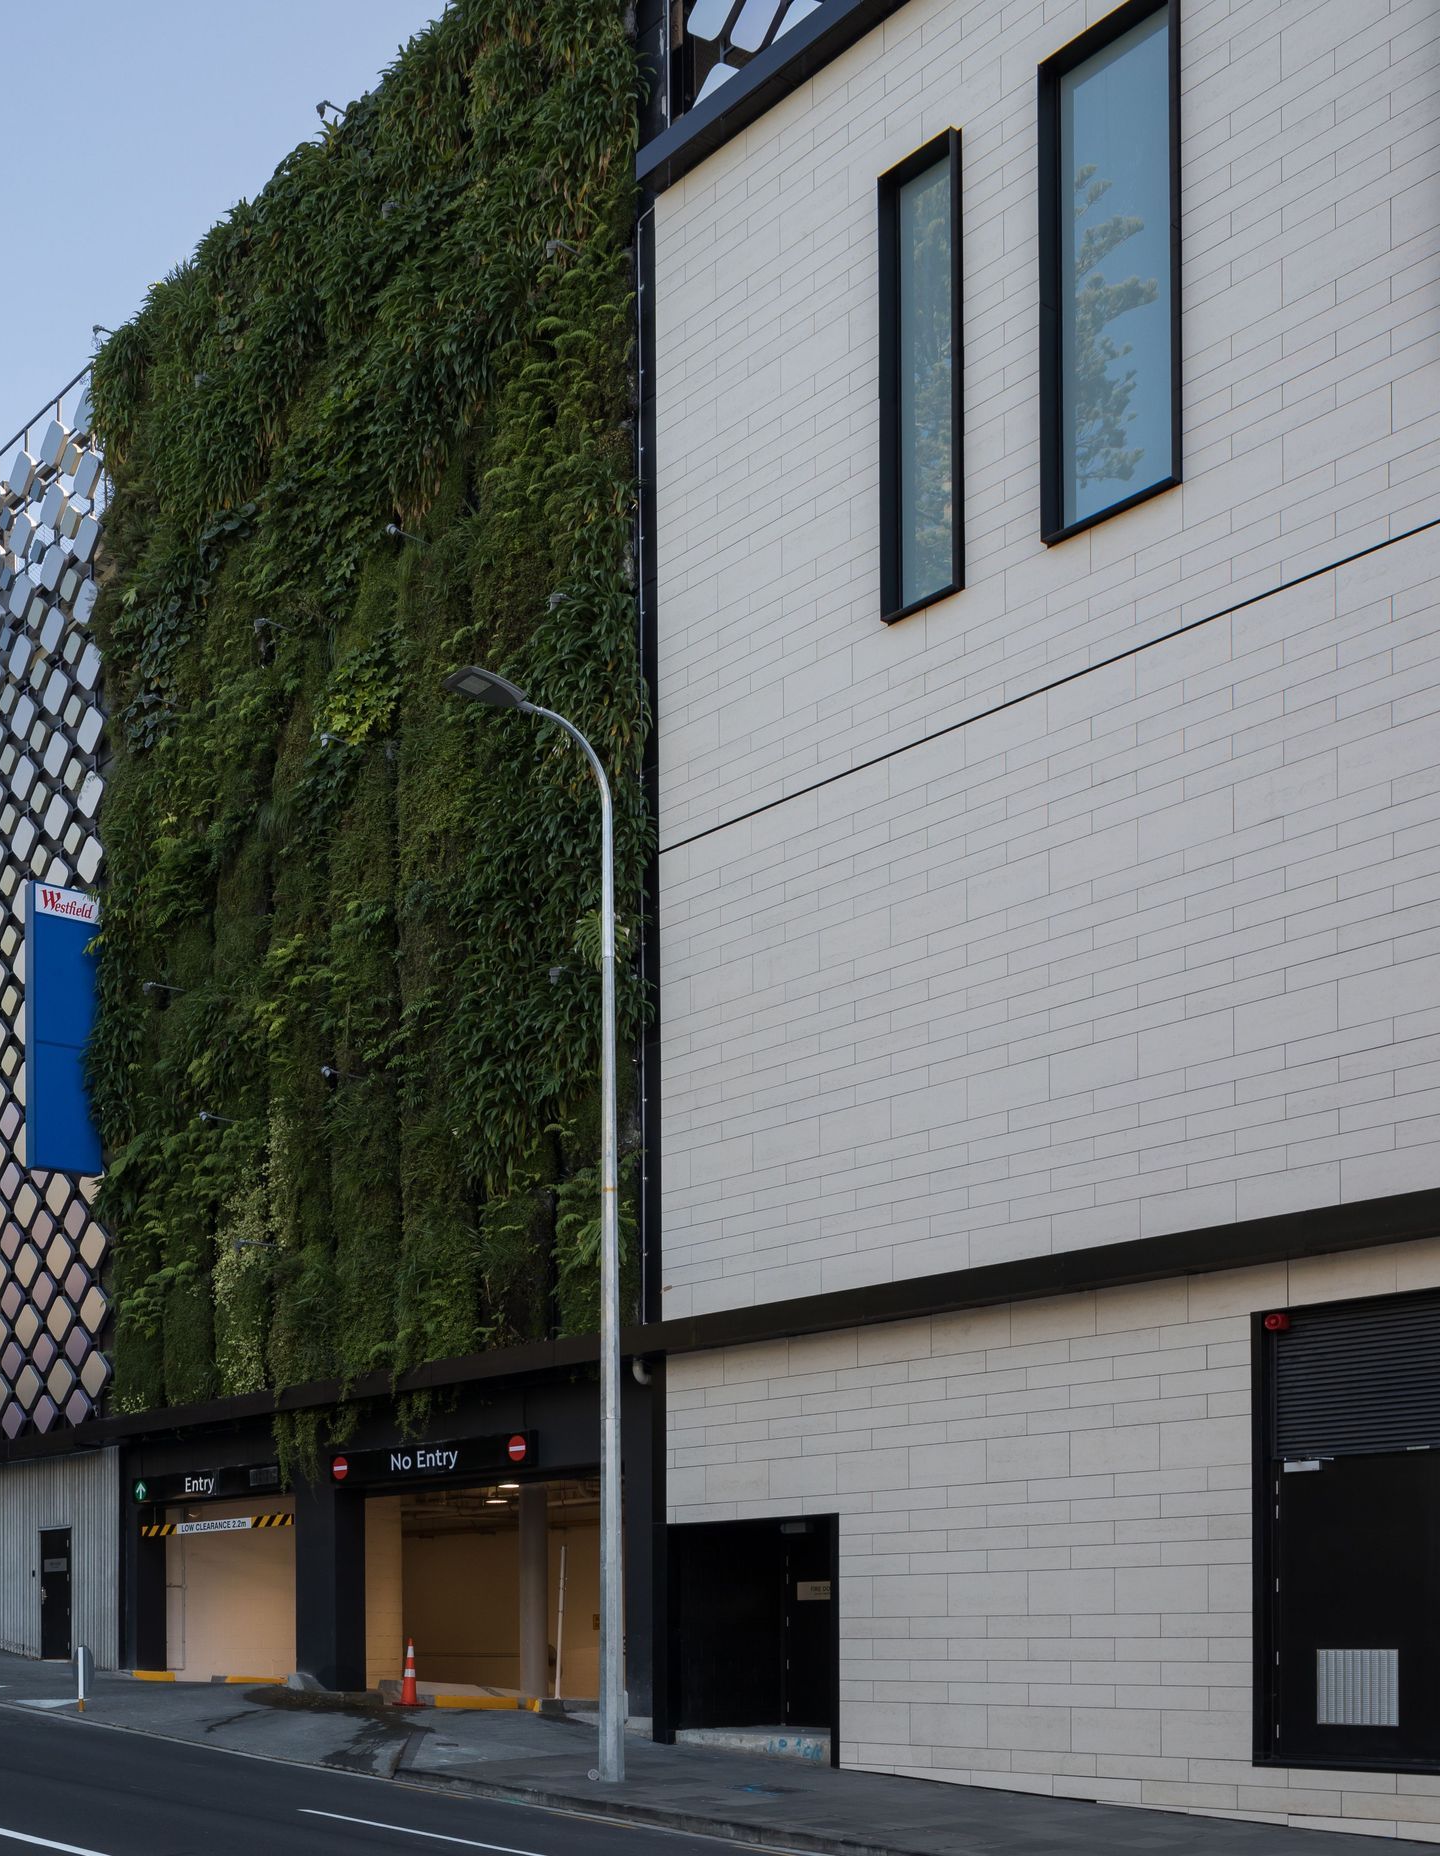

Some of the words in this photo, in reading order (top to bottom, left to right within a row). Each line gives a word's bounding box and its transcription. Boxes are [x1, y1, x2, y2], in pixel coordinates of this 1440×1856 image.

[41, 888, 94, 919] Westfield
[390, 1453, 412, 1471] No
[417, 1450, 458, 1469] Entry
[184, 1477, 215, 1494] Entry
[181, 1523, 194, 1533] LOW
[196, 1520, 231, 1531] CLEARANCE
[232, 1519, 247, 1528] 2.2m
